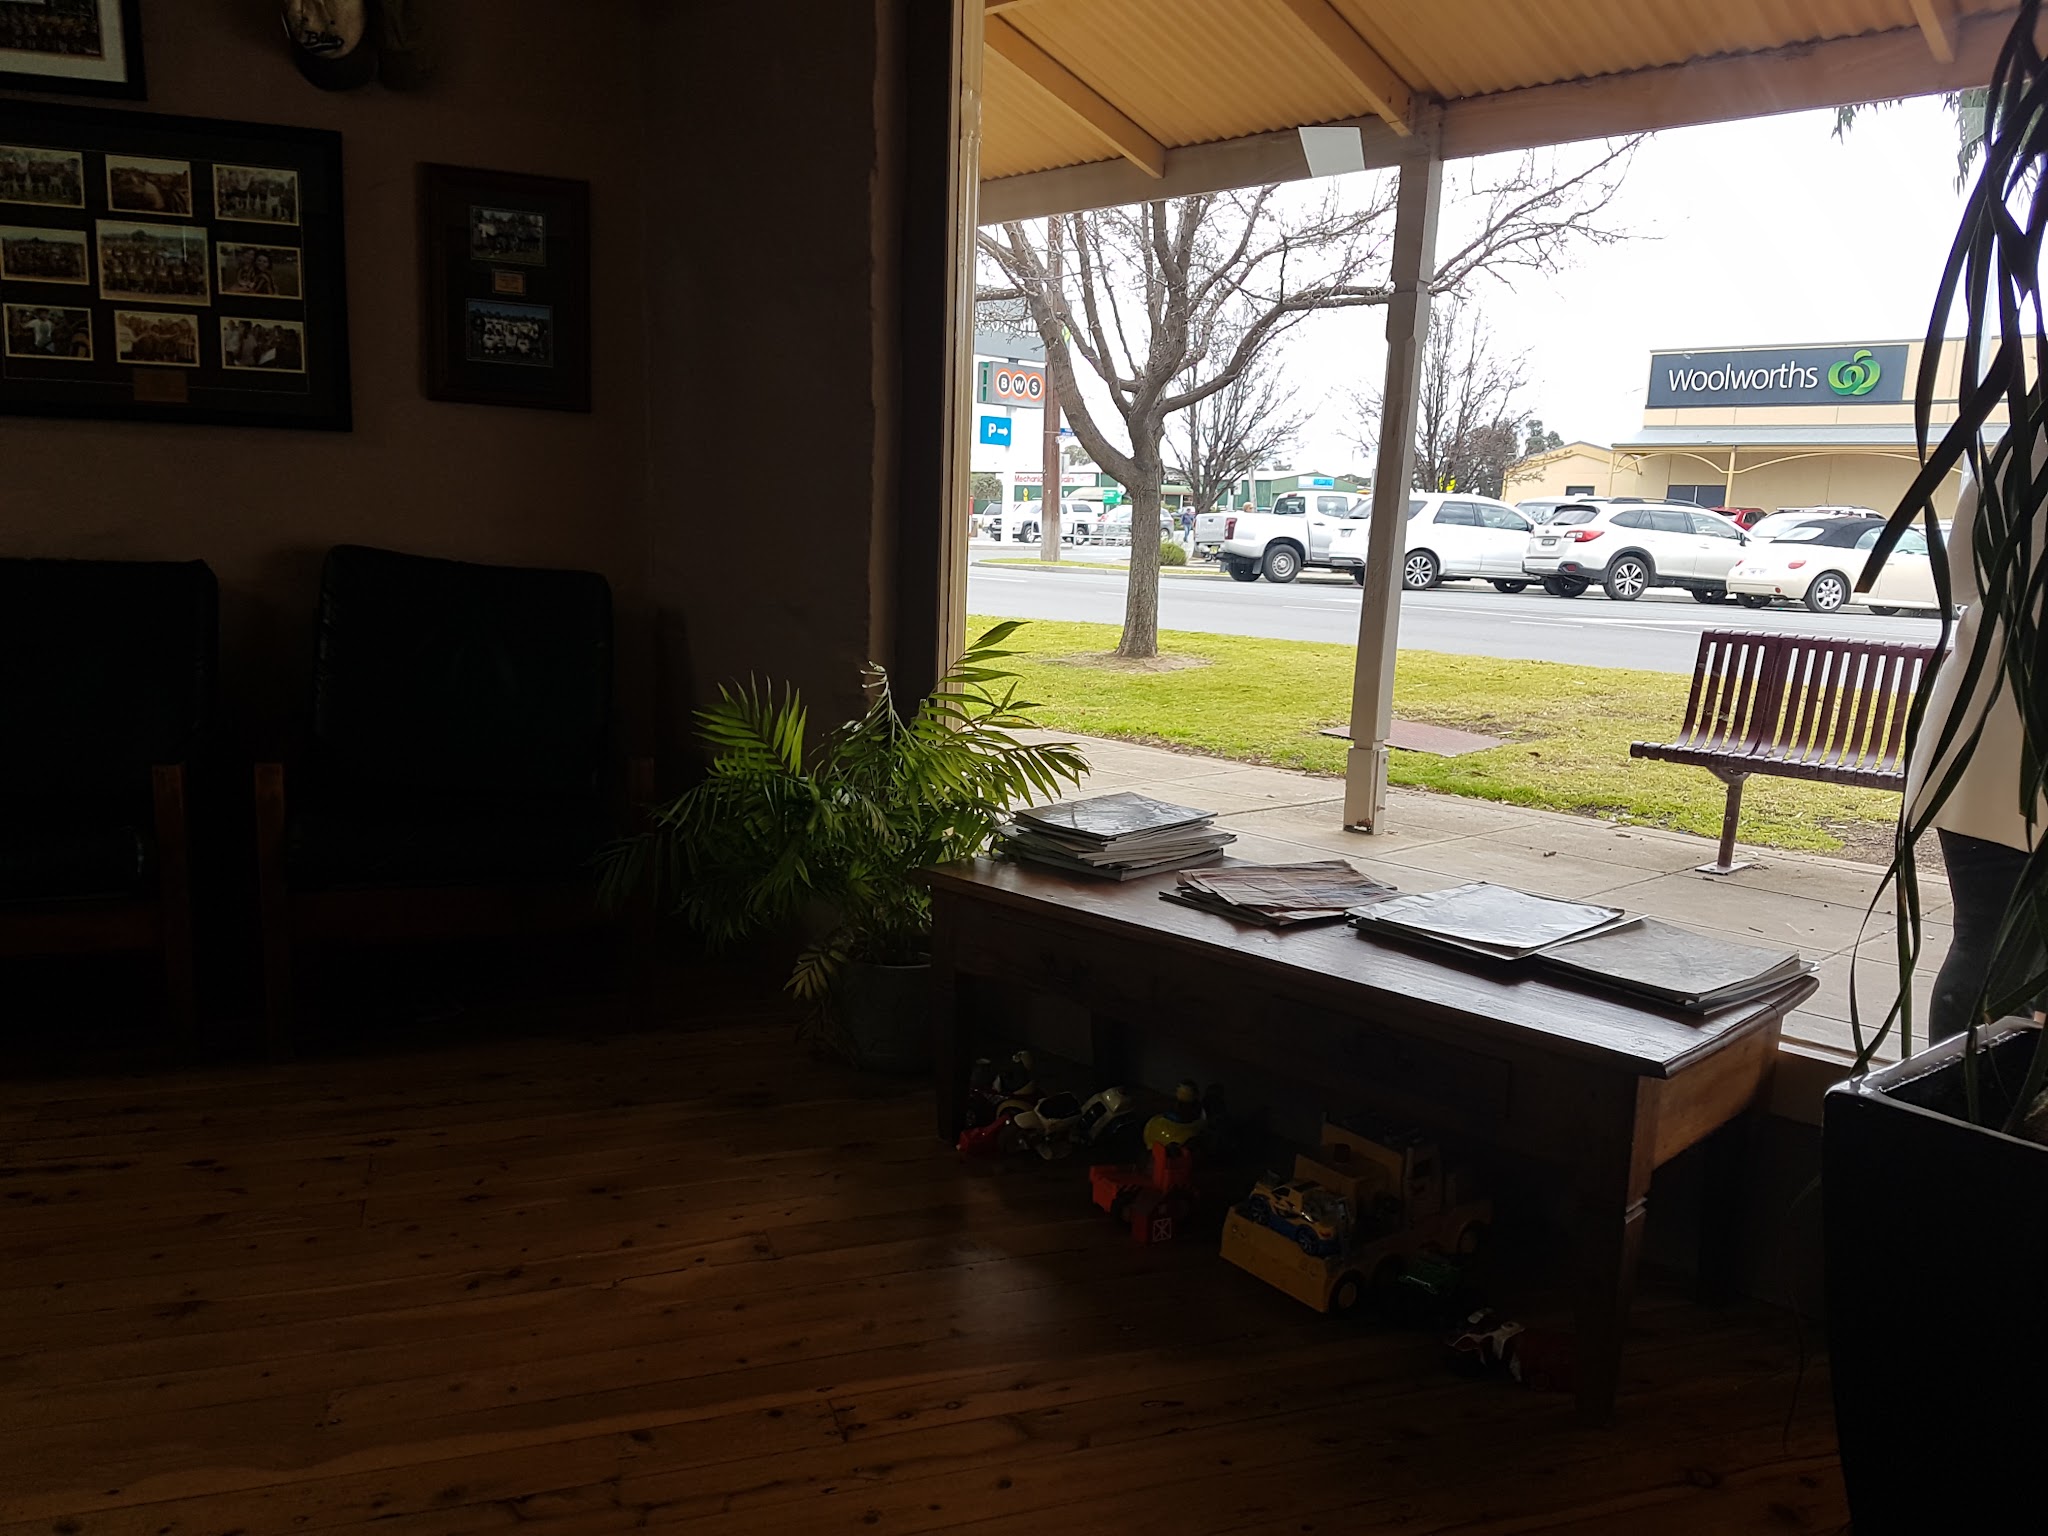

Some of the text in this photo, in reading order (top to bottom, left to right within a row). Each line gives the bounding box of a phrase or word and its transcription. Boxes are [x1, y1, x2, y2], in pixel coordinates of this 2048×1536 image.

[1668, 360, 1819, 392] Woolworths
[1000, 377, 1039, 393] BWS
[987, 422, 997, 438] P
